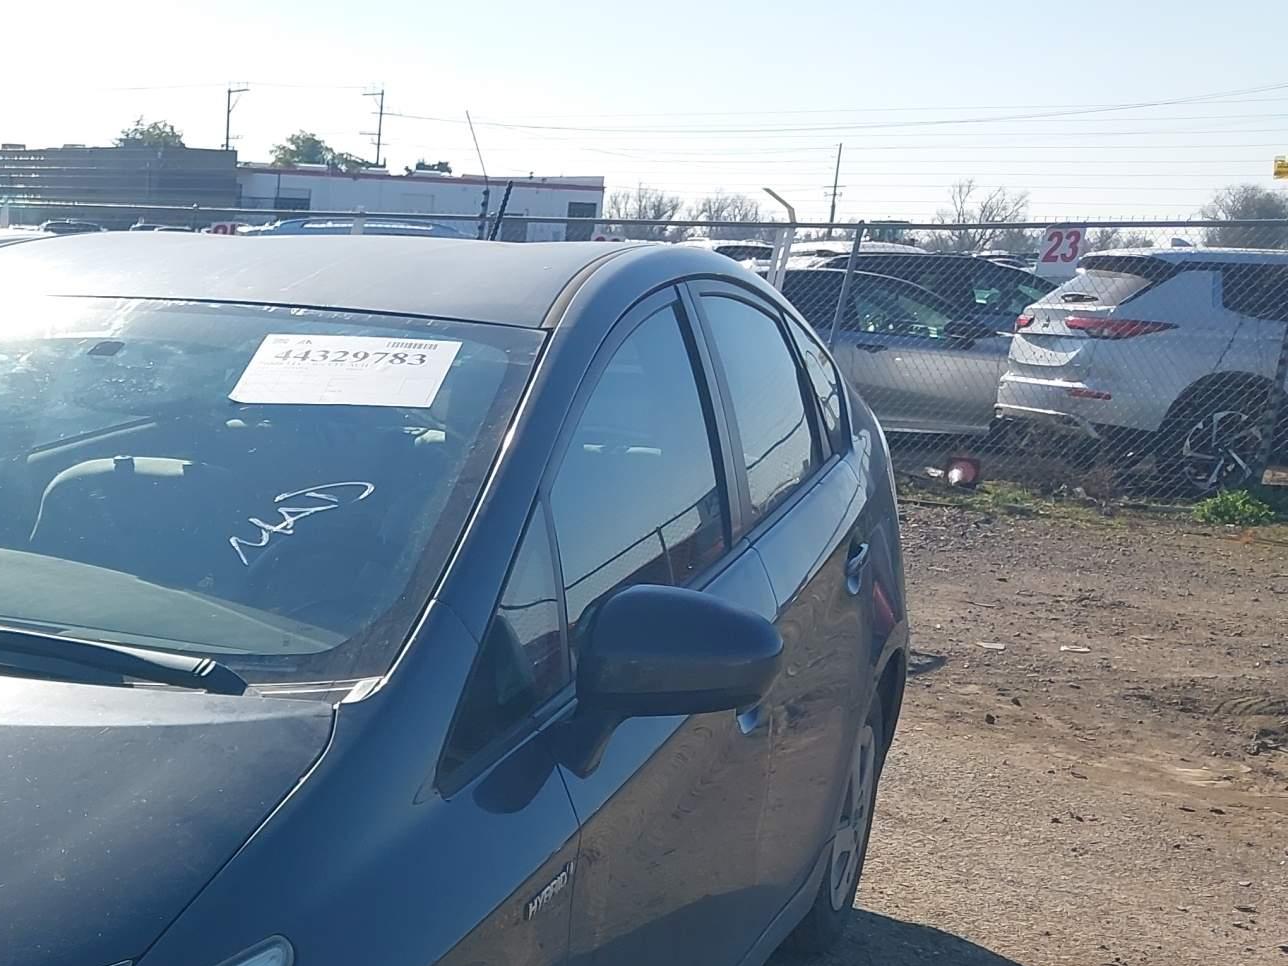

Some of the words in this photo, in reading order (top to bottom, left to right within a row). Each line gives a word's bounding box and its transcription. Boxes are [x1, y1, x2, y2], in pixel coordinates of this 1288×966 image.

[1041, 230, 1082, 263] 23
[274, 348, 428, 367] 44329783
[527, 871, 568, 920] HYBRID
